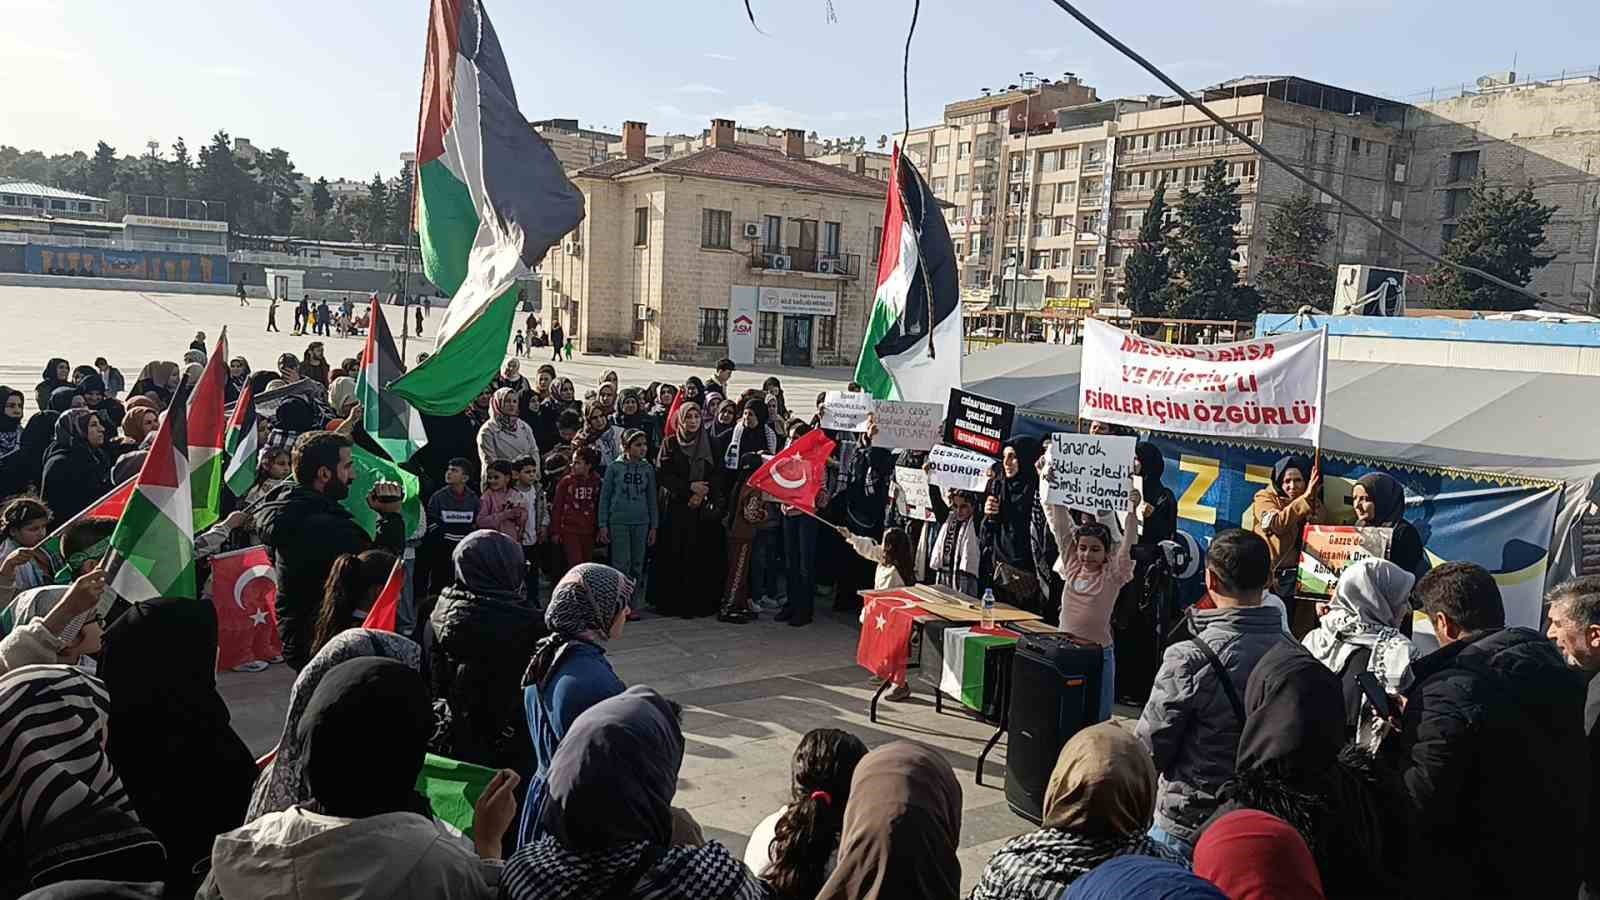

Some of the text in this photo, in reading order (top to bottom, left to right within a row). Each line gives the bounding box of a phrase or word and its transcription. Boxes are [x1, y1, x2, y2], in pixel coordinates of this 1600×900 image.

[732, 325, 752, 334] ASM
[1145, 393, 1190, 424] İÇİN
[1193, 399, 1317, 425] ÖZGÜRLÜ
[1062, 493, 1129, 511] SUSMA!!!
